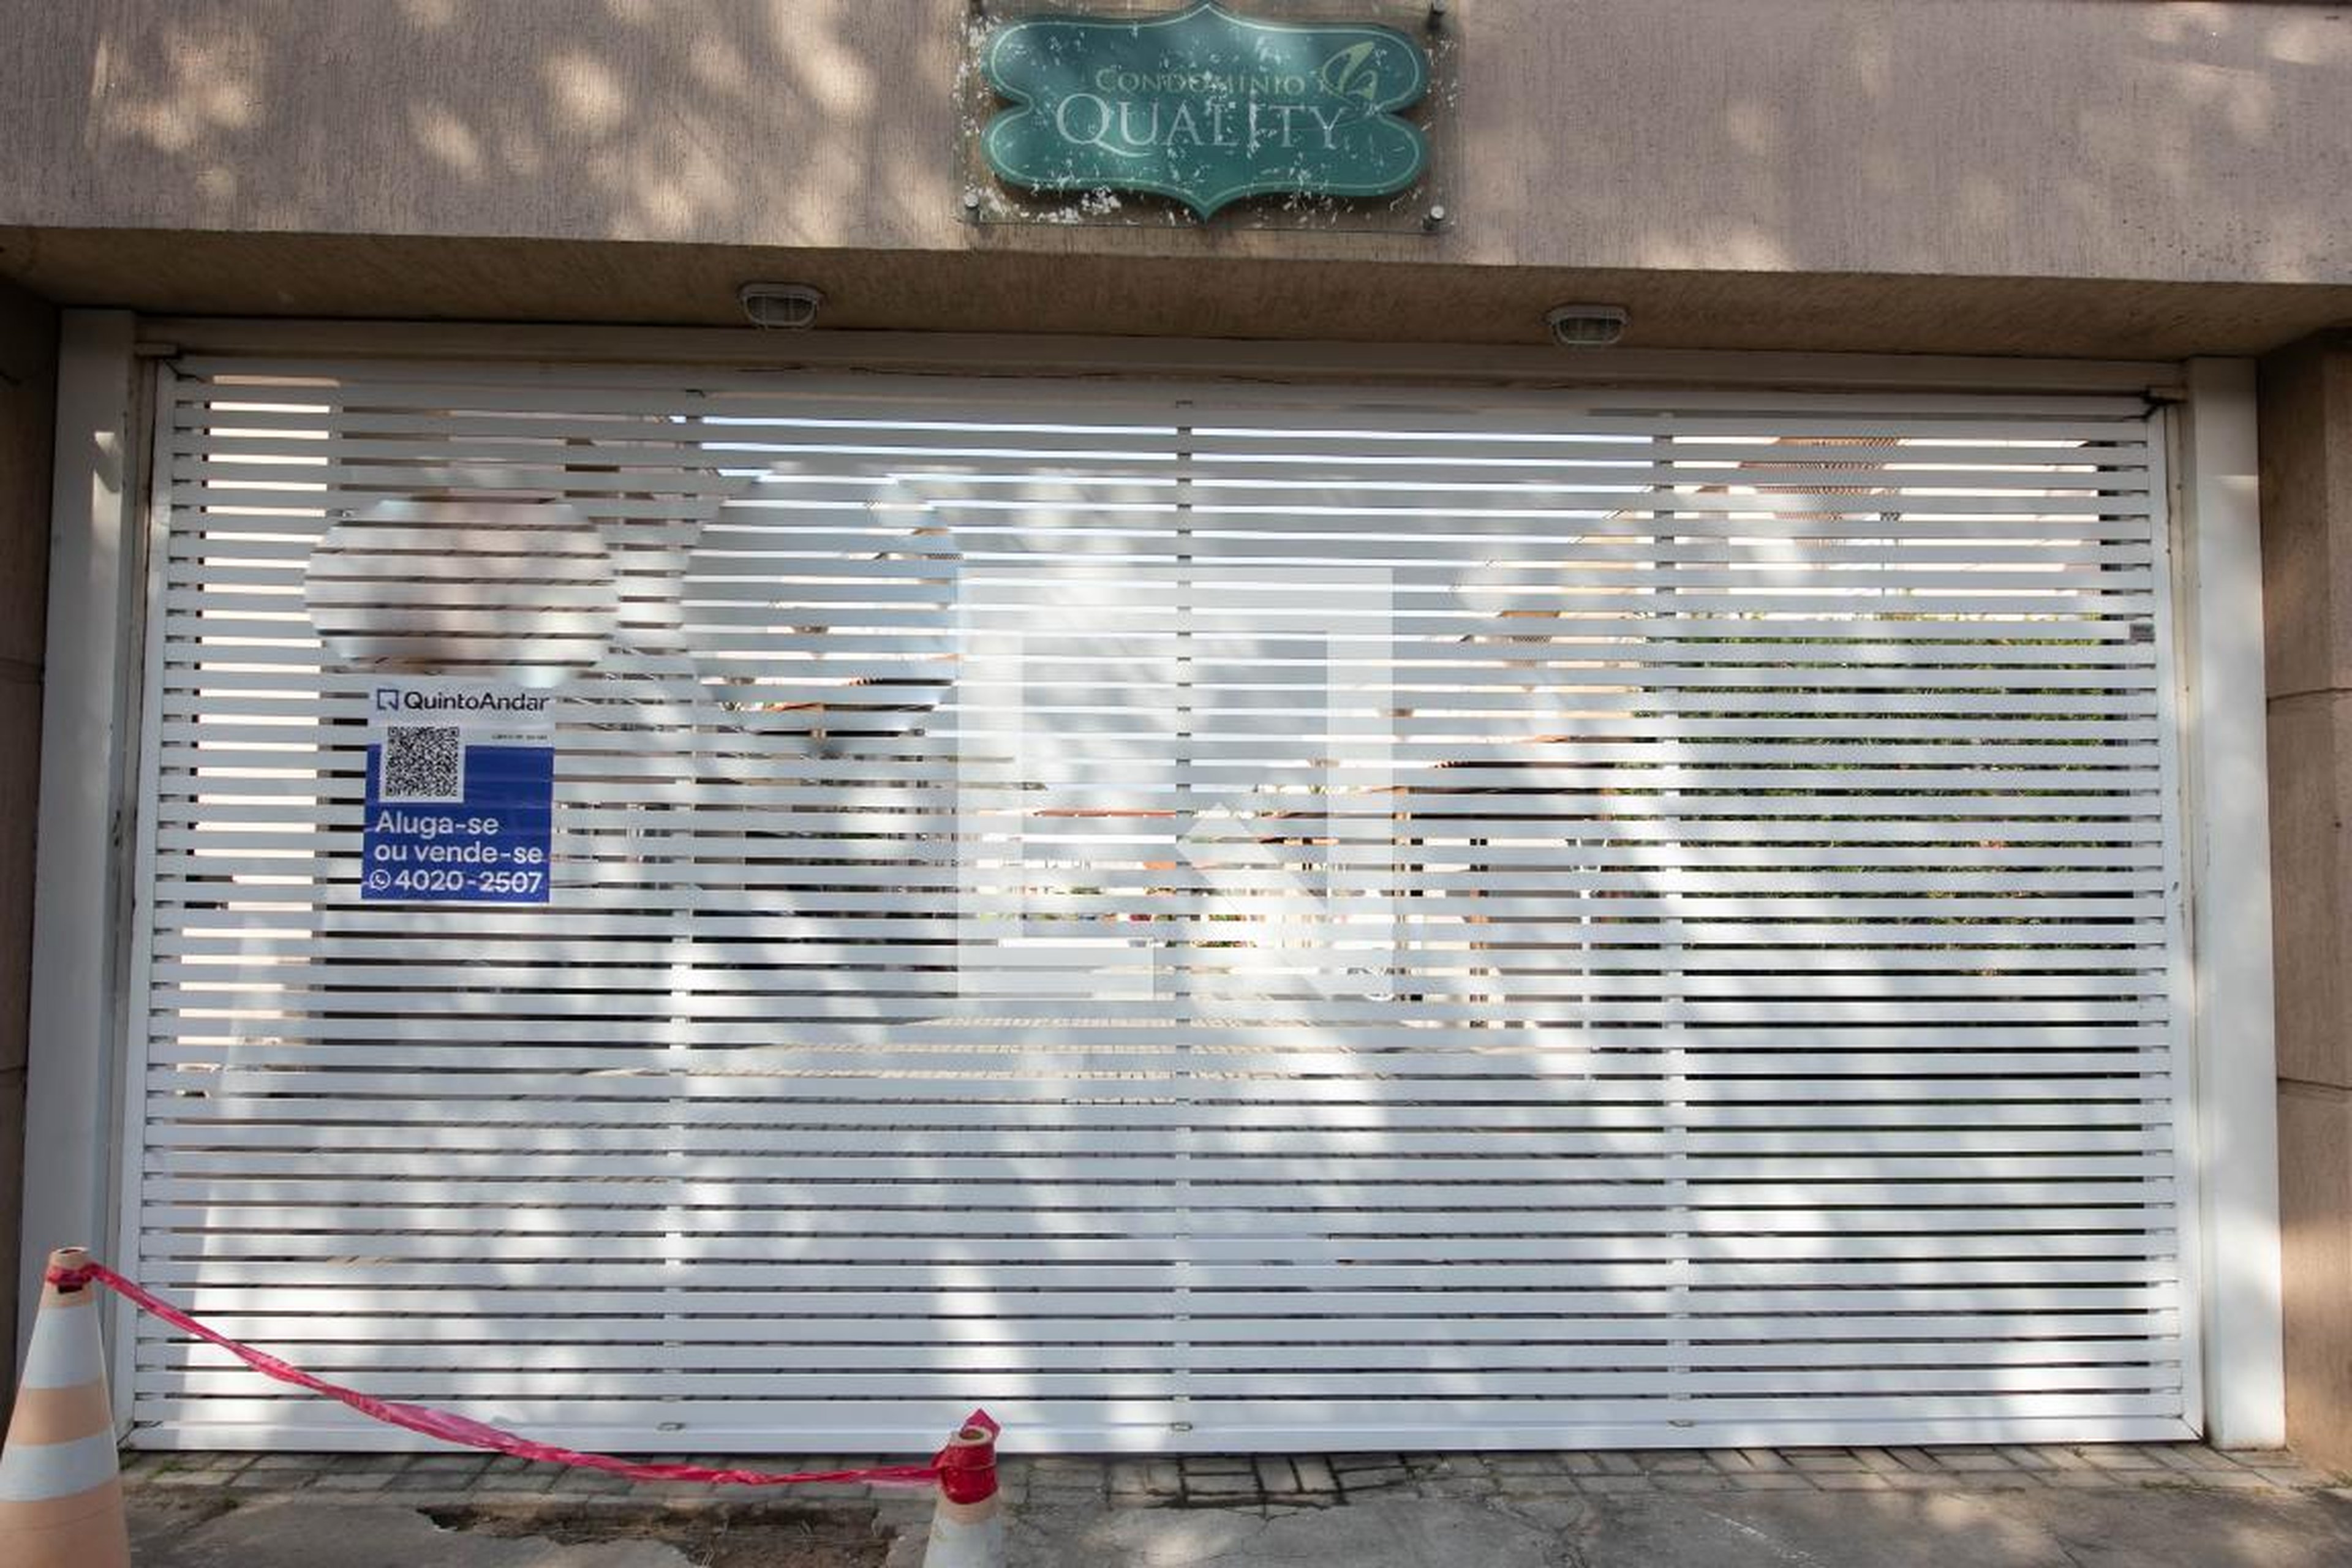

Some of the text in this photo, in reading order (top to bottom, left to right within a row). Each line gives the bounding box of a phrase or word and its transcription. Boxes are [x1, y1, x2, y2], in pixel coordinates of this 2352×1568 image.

[1057, 92, 1347, 157] QUALITY
[404, 692, 549, 711] QuintoAndar
[375, 811, 499, 839] Aluga-se
[374, 842, 543, 864] ou vende-se
[395, 870, 542, 893] 4020-2507
